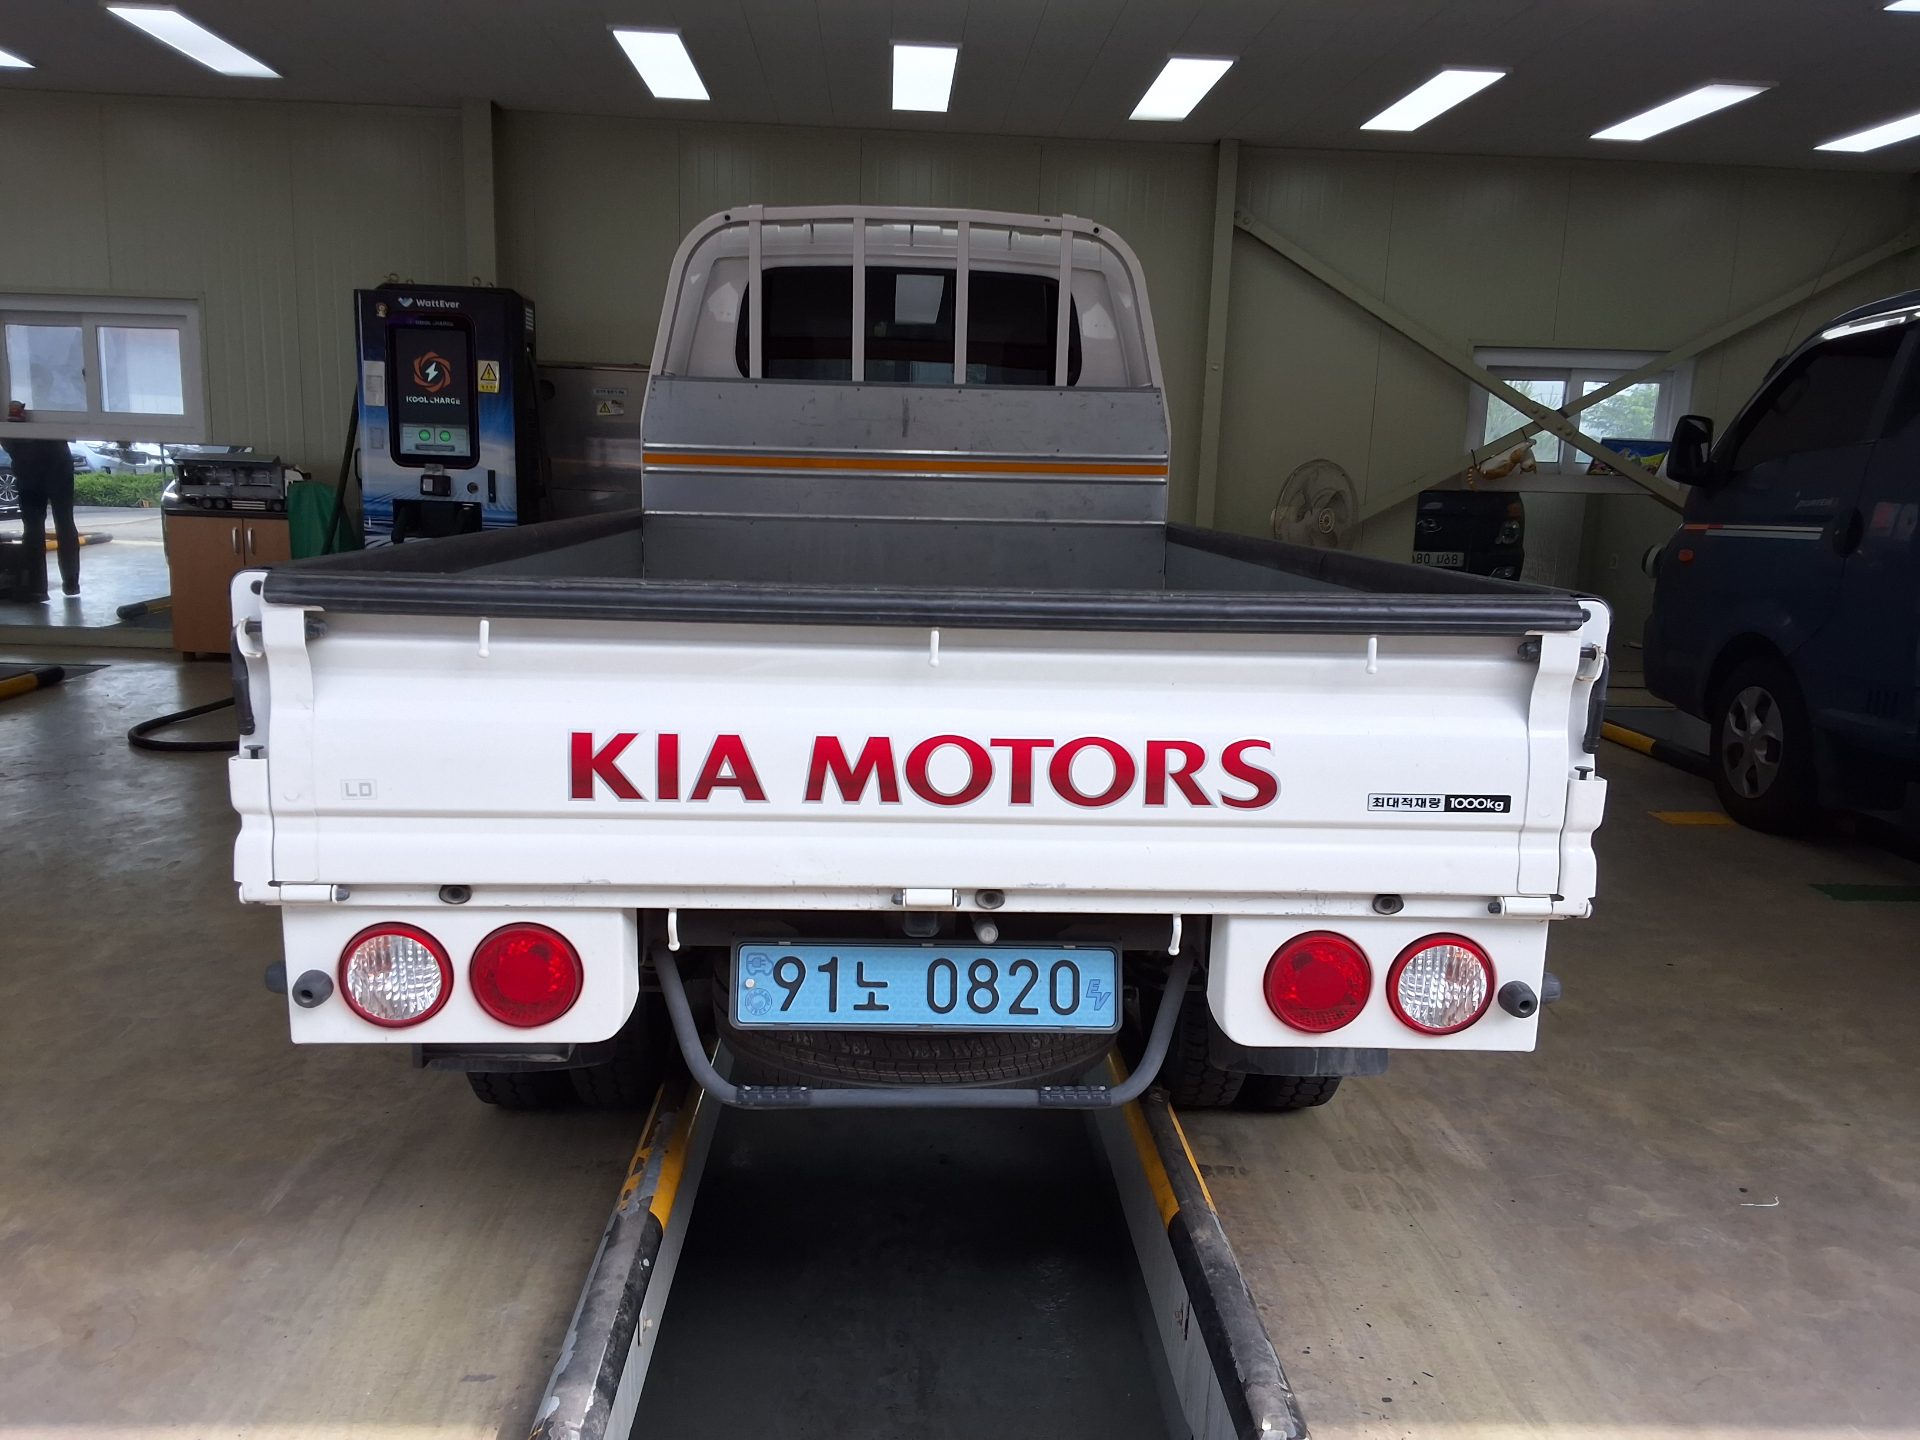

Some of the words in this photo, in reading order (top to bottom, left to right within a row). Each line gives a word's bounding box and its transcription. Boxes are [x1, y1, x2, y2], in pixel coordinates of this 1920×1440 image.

[415, 298, 461, 309] WattEver
[405, 395, 429, 404] KOOL
[568, 729, 771, 804] KIA
[802, 733, 1282, 811] MOTORS
[1371, 796, 1442, 809] 최대적재량
[1449, 797, 1504, 812] 1000kg
[772, 955, 891, 1014] 91노
[926, 957, 1081, 1016] 0820
[1085, 978, 1112, 1012] EV
